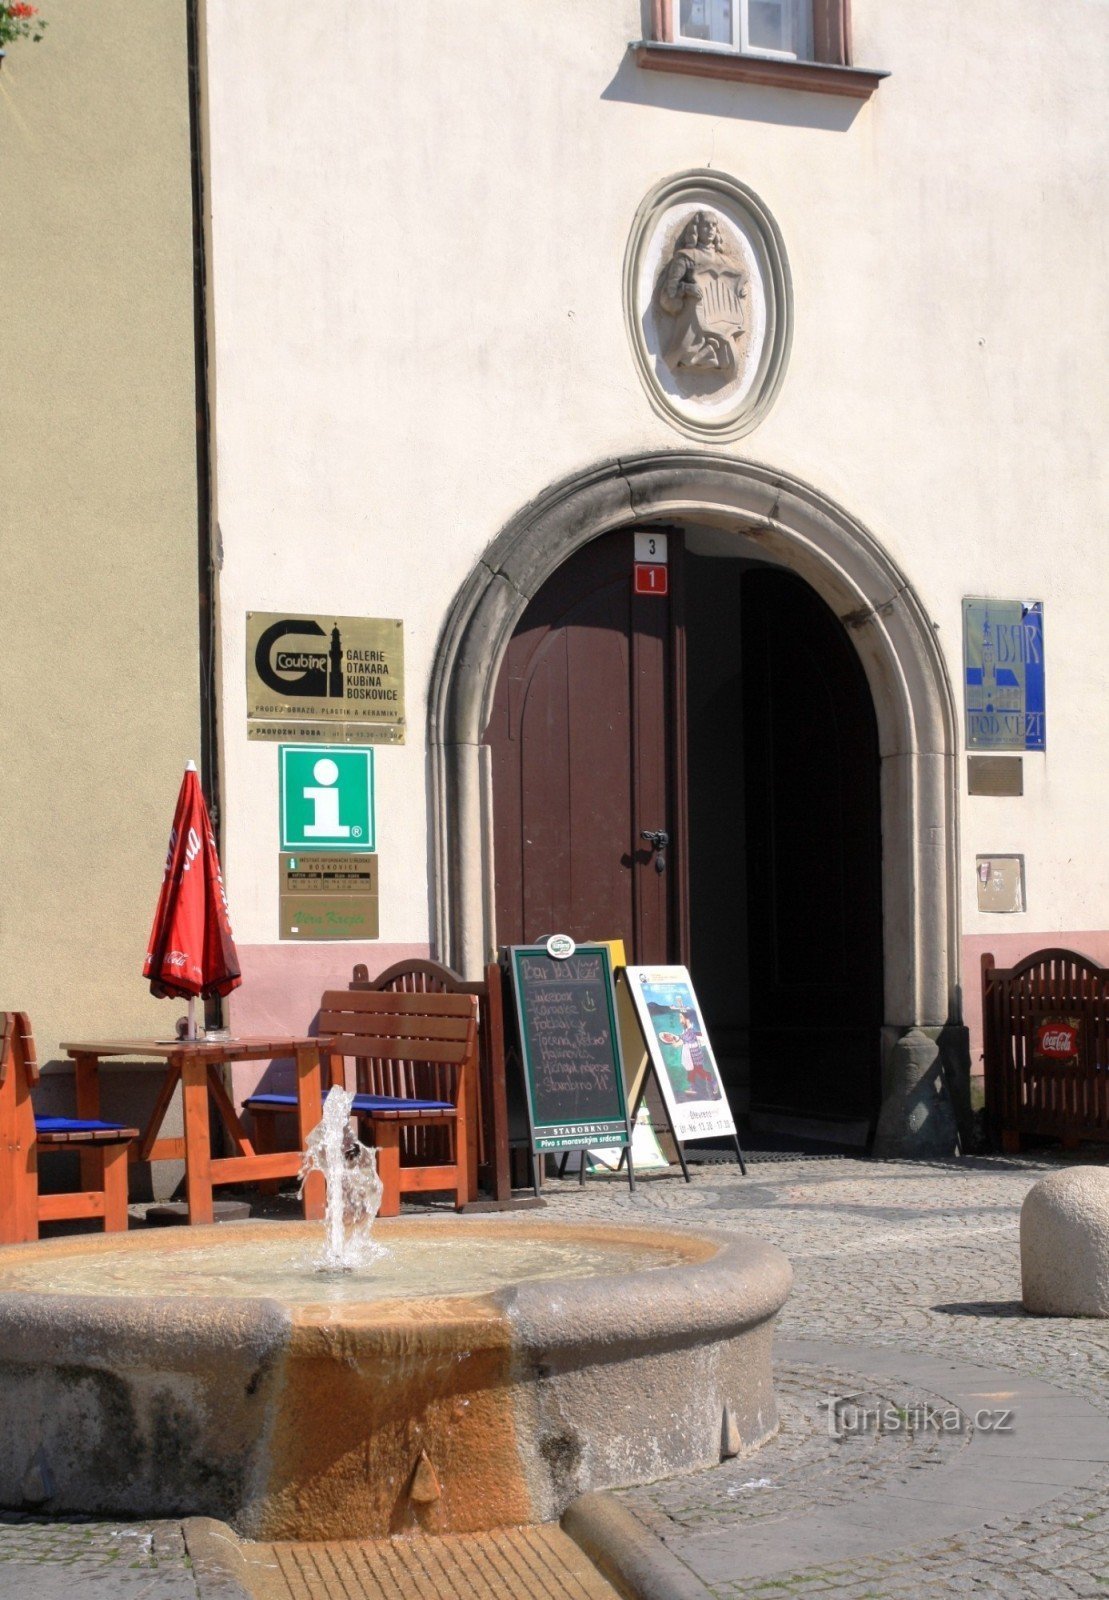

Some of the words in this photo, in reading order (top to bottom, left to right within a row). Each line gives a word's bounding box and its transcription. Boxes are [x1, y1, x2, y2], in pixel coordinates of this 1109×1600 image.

[648, 538, 656, 555] 3
[648, 570, 656, 588] 1
[996, 624, 1040, 664] BAR
[278, 653, 327, 672] Coubine
[346, 649, 385, 662] GALERIE
[346, 662, 389, 675] OTAKARA
[346, 688, 398, 700] BOSKOVICE
[968, 714, 1000, 734] POD
[553, 1125, 609, 1135] STAROBRNO
[541, 1140, 555, 1148] Pivo
[562, 1136, 598, 1146] moravským
[599, 1134, 622, 1142] srdcem
